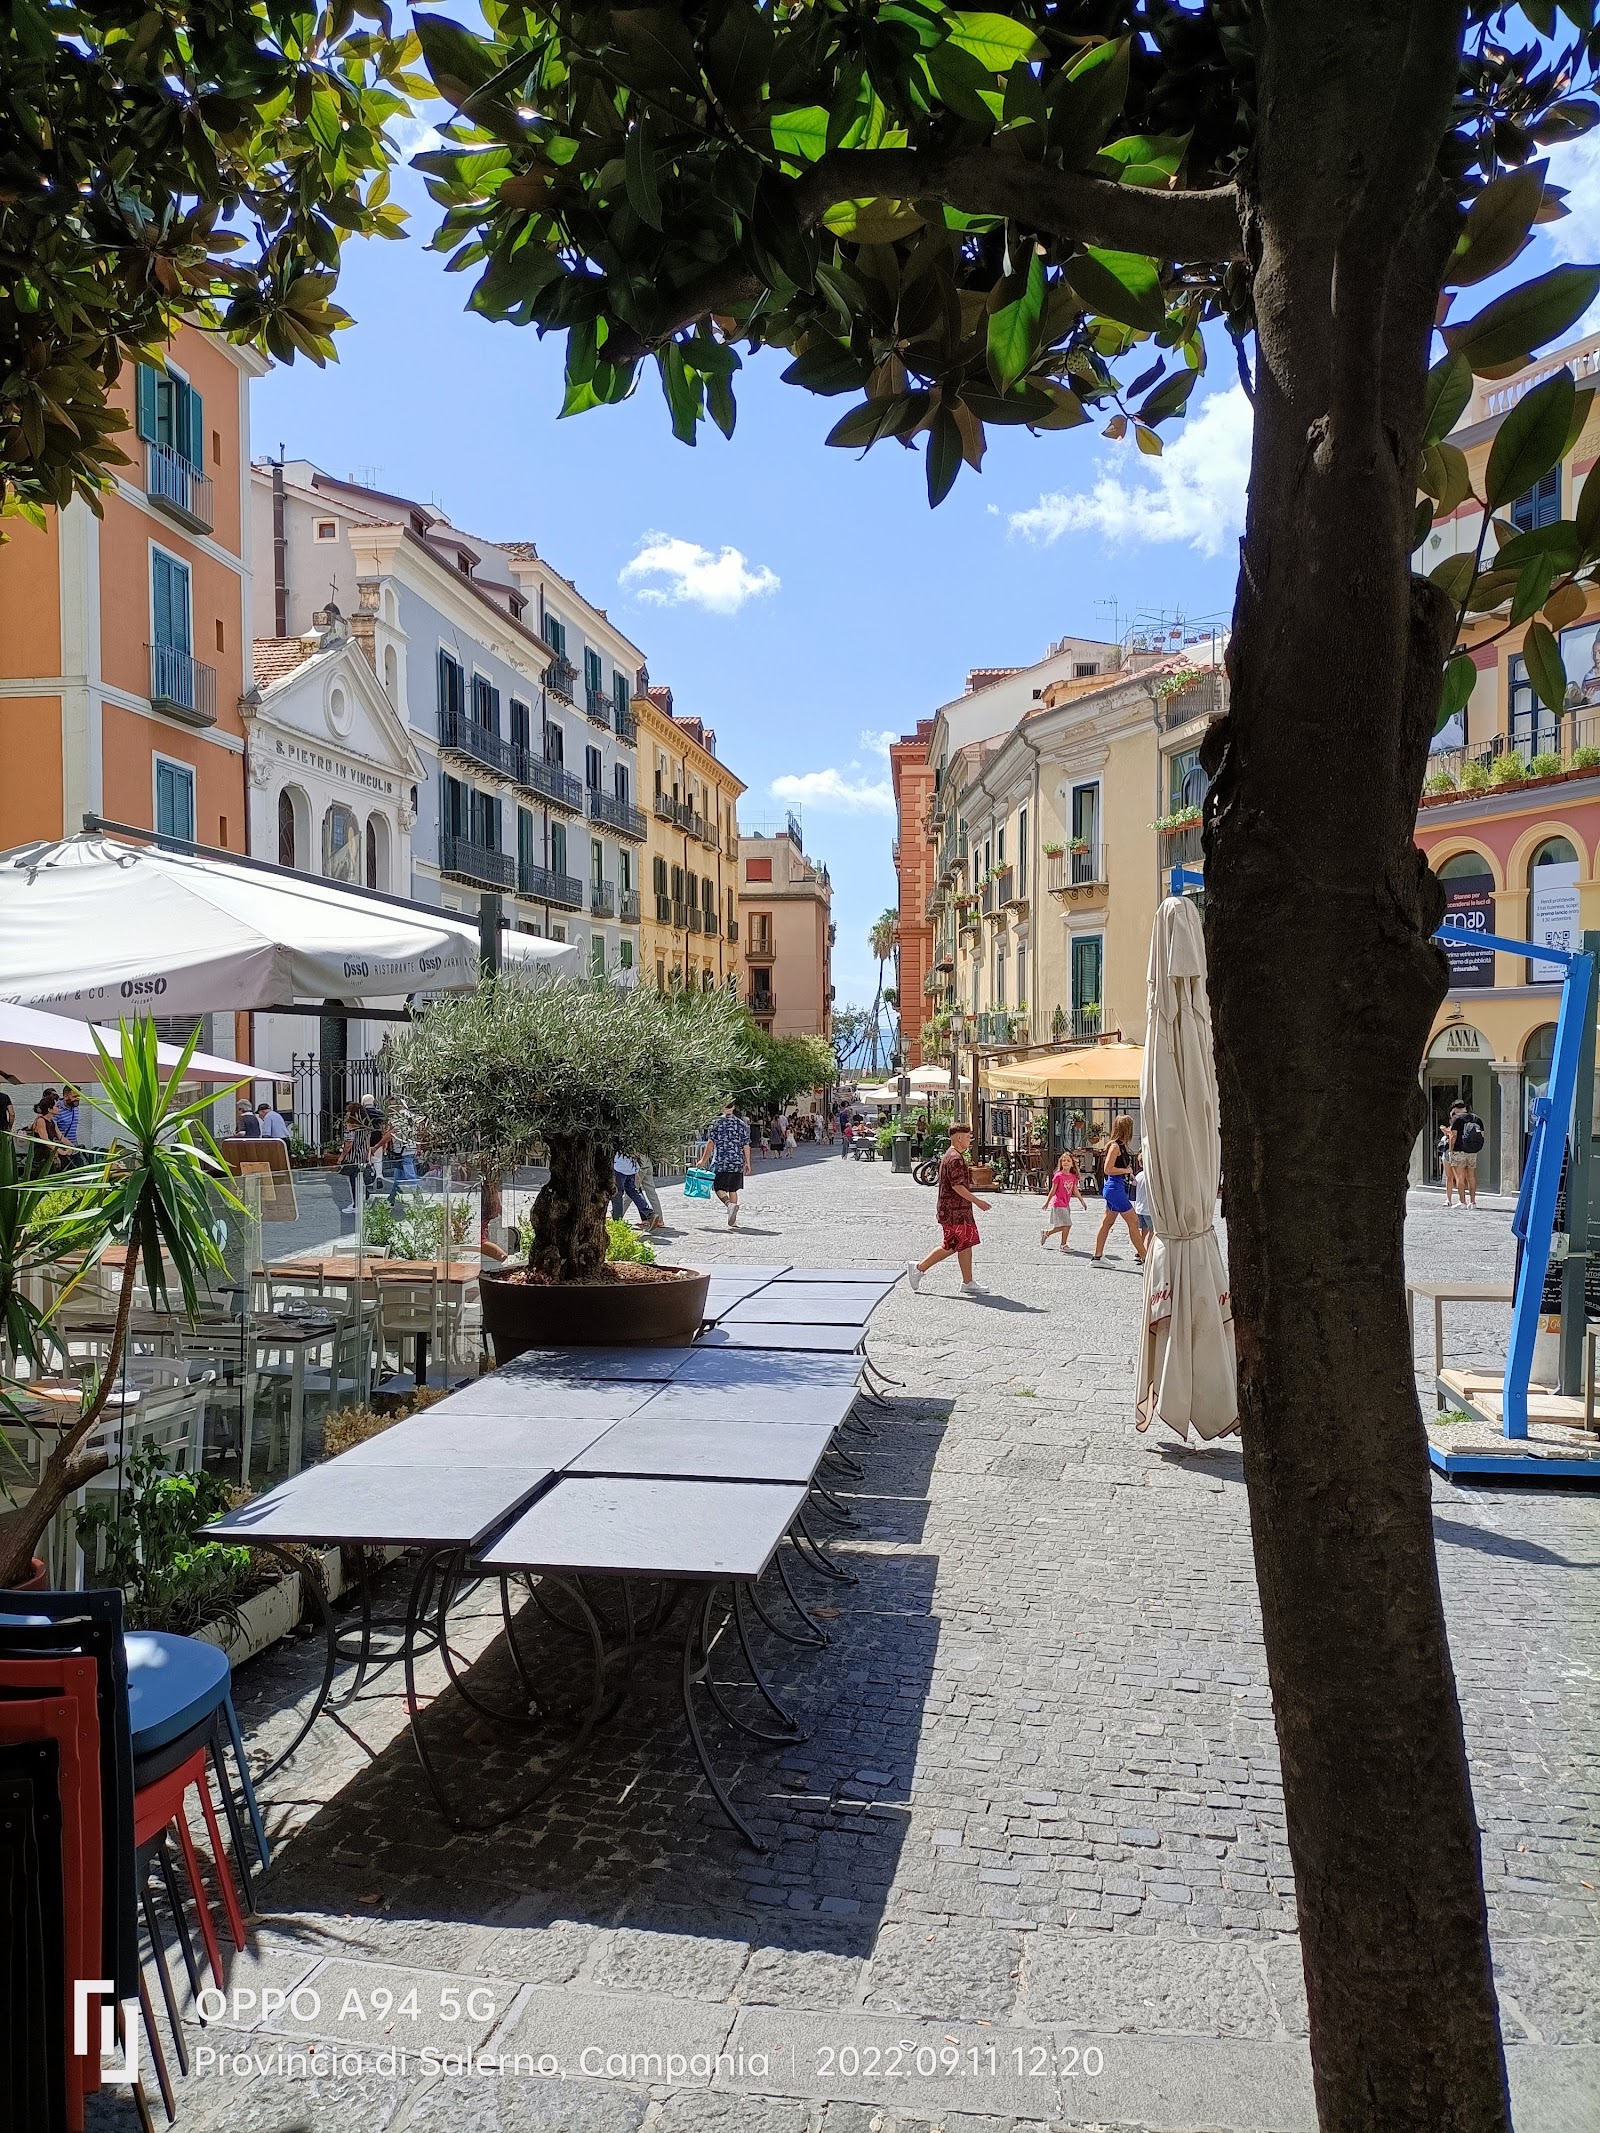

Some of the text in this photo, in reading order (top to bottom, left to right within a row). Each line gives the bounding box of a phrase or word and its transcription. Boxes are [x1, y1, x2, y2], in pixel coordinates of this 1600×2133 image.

[275, 739, 392, 794] S. PIETRO IN VINCULIS
[374, 961, 415, 975] RISTORANTE
[30, 991, 68, 1004] CARNI
[74, 989, 81, 1000] &
[88, 986, 110, 998] CO.
[1447, 1029, 1479, 1047] ANNA
